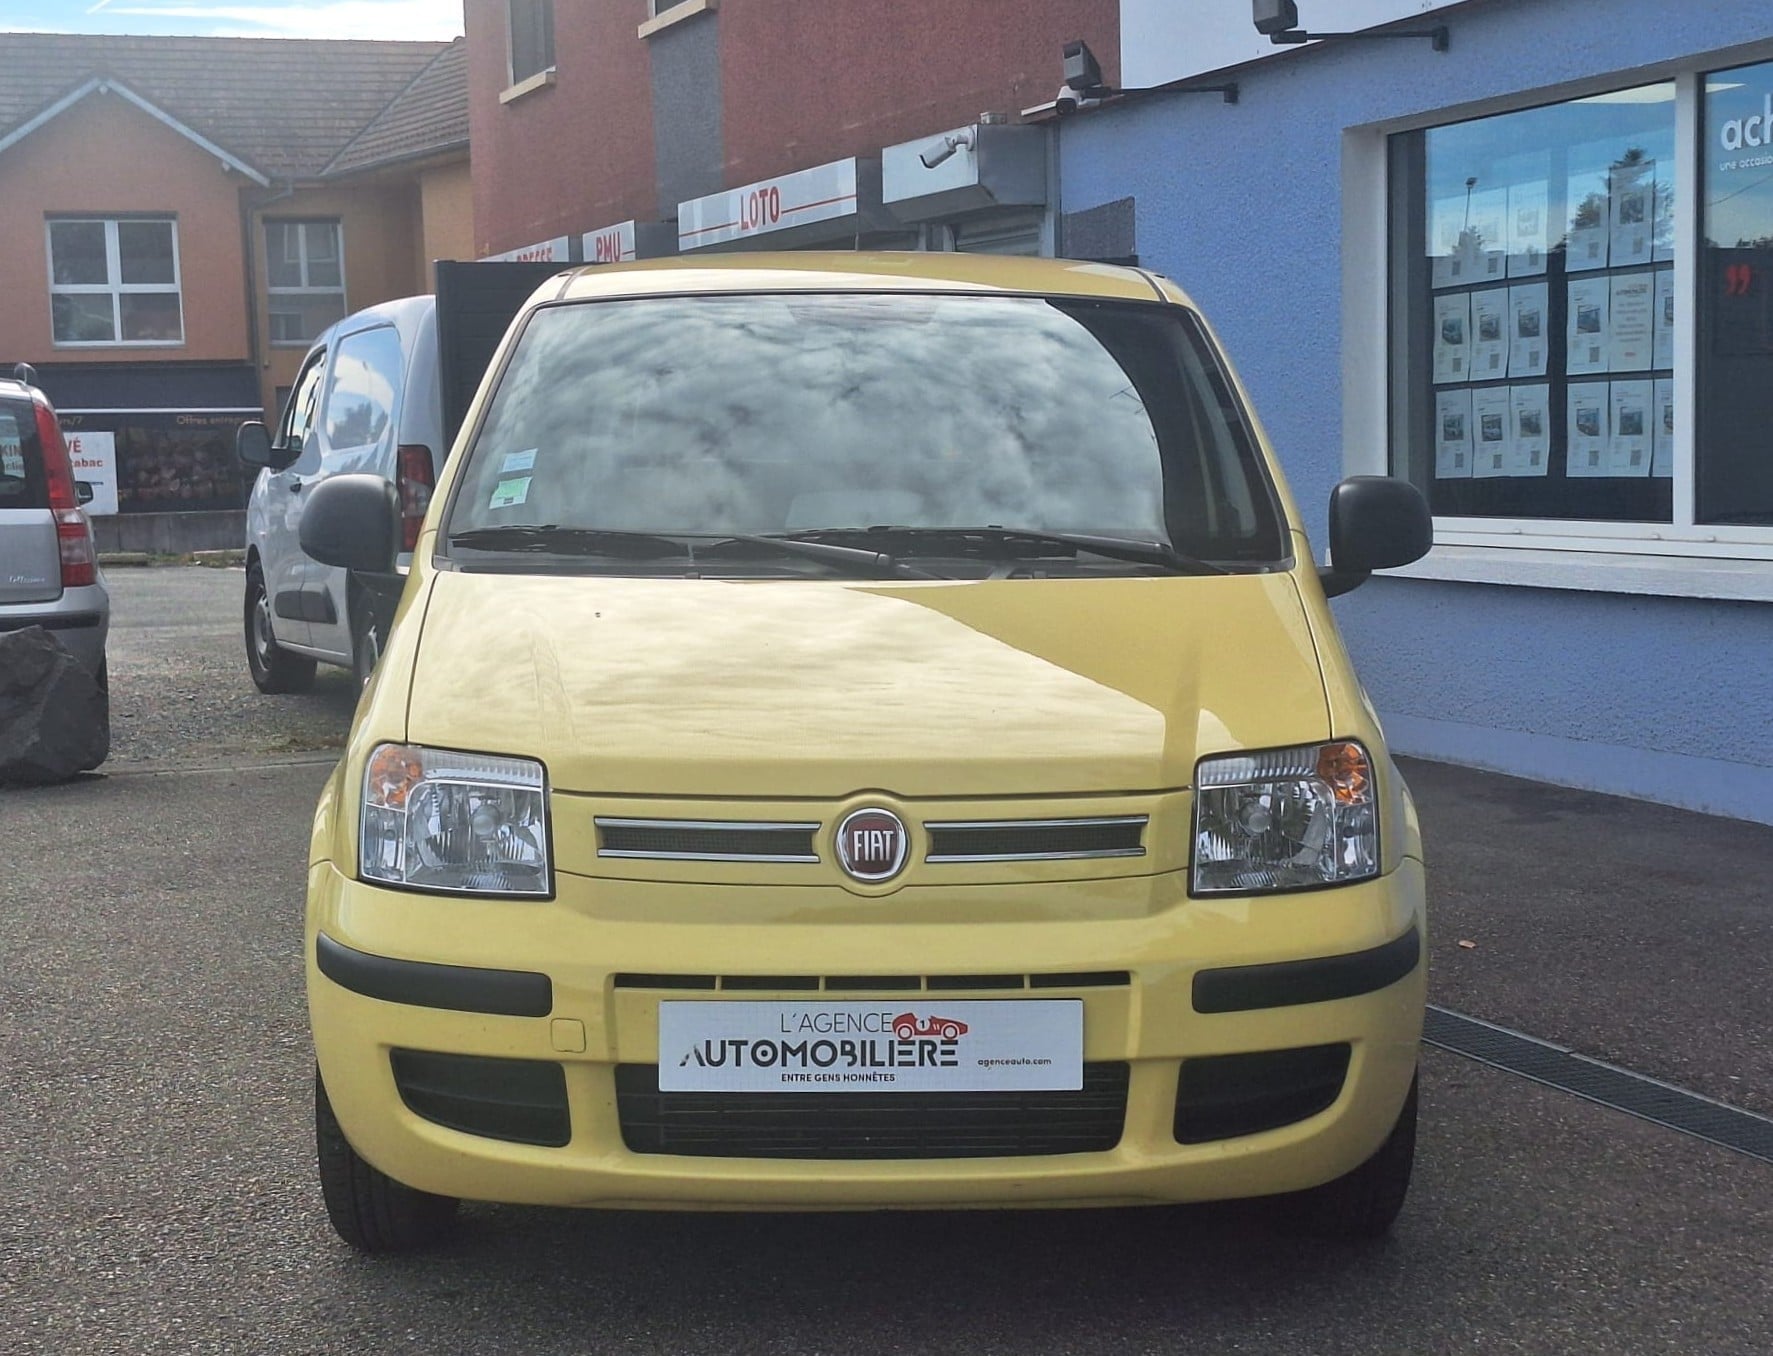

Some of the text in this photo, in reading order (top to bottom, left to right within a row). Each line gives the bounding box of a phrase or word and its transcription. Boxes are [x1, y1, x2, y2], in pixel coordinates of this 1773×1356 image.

[741, 186, 779, 230] LOTO
[596, 231, 621, 262] PMU
[853, 830, 894, 861] FIAT
[781, 1013, 893, 1033] L'AGENCE
[679, 1040, 958, 1067] AUTOMOBILIERE
[977, 1058, 1052, 1067] agenceauto.com
[781, 1071, 895, 1082] ENTRE GENS HONNÊTES
